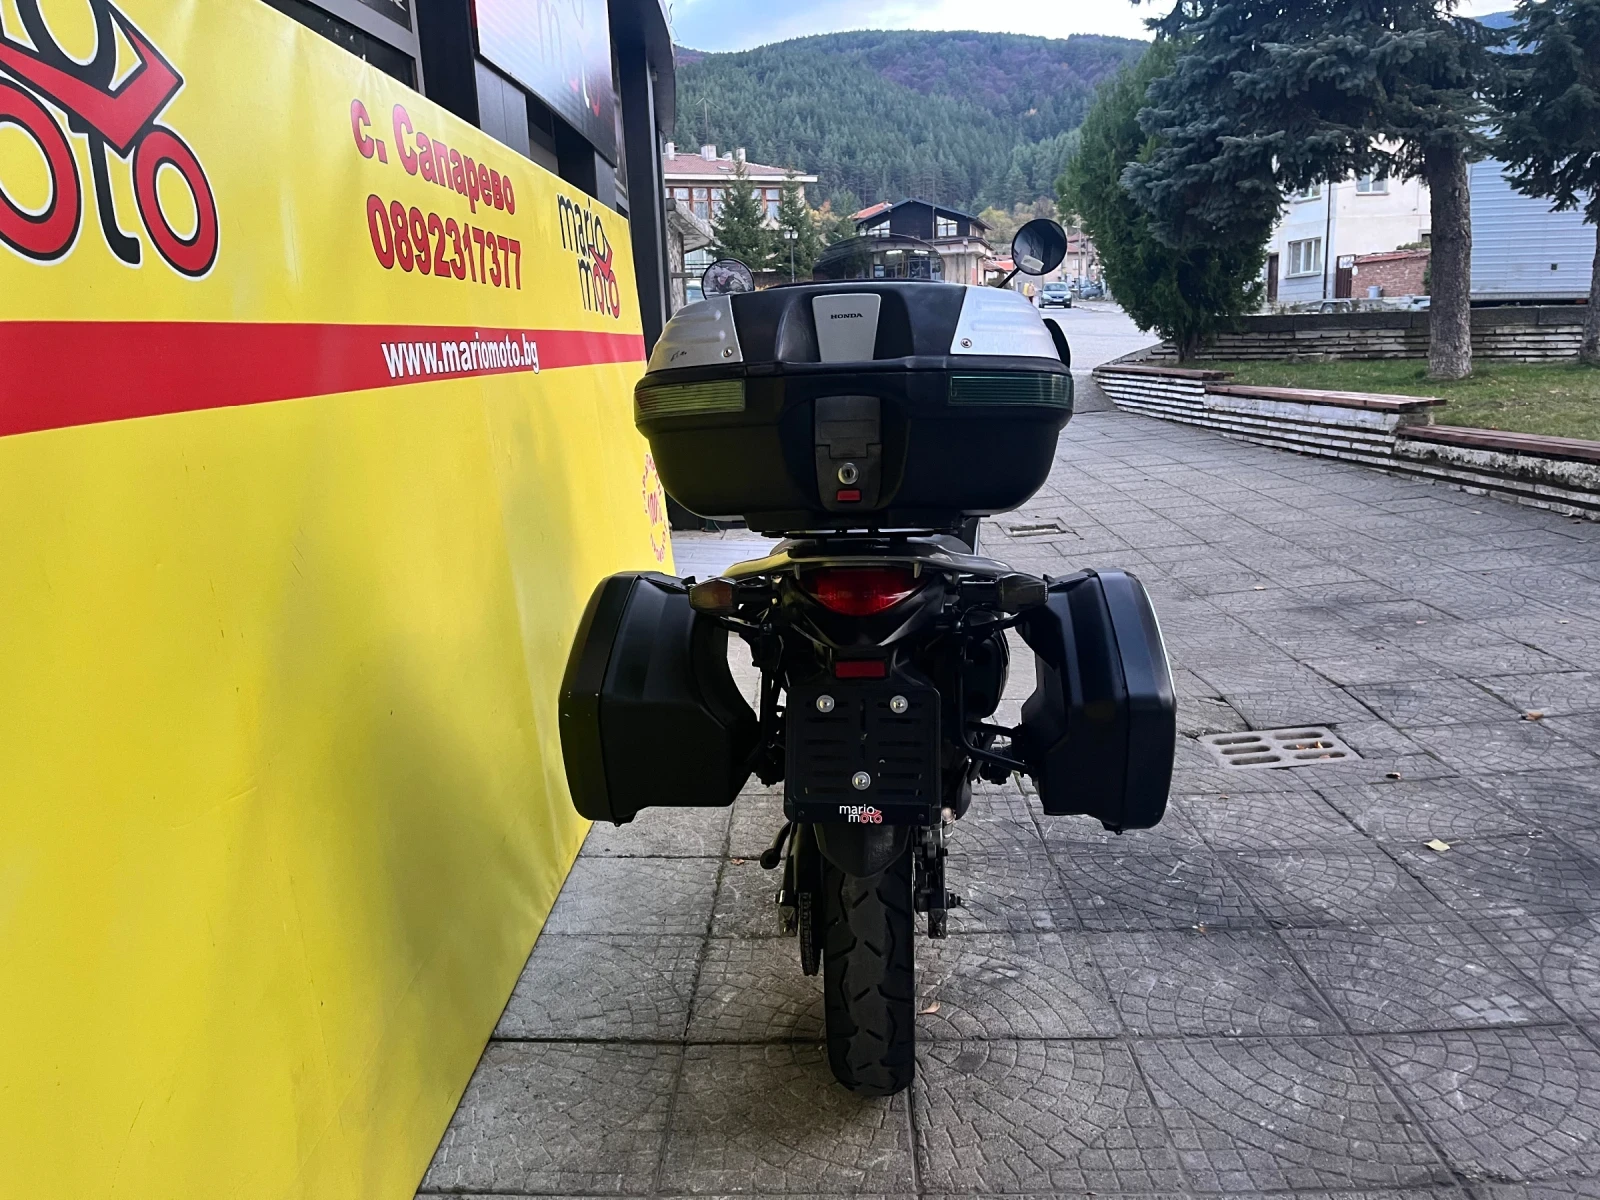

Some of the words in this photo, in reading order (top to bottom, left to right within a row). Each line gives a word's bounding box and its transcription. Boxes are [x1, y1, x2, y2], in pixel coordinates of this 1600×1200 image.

[0, 74, 220, 282] oto
[392, 103, 515, 215] Сапарево
[366, 193, 522, 290] 0892317377
[556, 194, 607, 262] mario
[577, 259, 620, 319] moto
[829, 312, 863, 320] HONDA
[380, 331, 540, 378] www.mariomoto.bg
[839, 803, 875, 814] mario
[848, 813, 882, 824] moto
